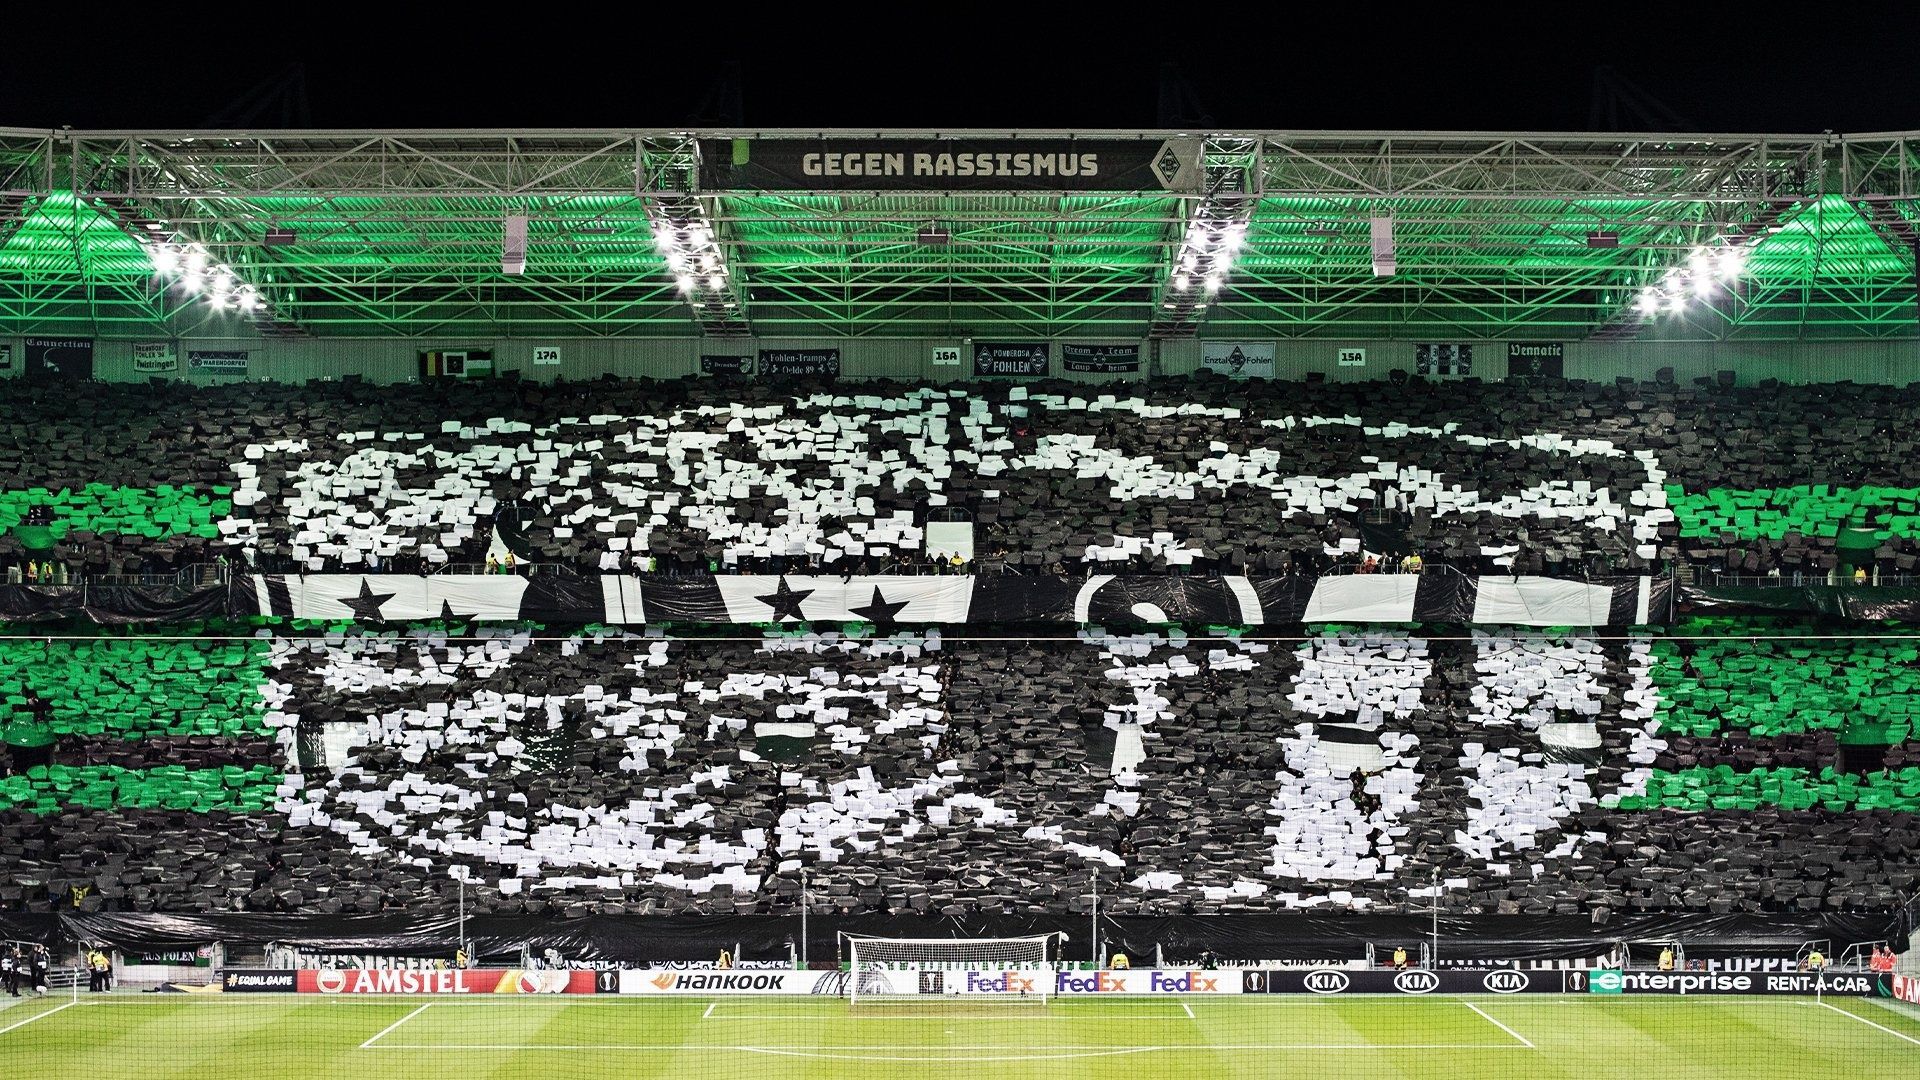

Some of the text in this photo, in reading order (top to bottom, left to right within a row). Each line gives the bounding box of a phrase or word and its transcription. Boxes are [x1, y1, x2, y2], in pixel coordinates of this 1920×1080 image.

[803, 153, 1098, 176] GEGEN RASSISMUS
[26, 338, 91, 348] Connection
[537, 351, 557, 359] 17A
[770, 353, 827, 363] Fohlen-Tramps
[935, 352, 957, 360] 16A
[993, 349, 1030, 357] PONDEROSA
[1341, 352, 1362, 361] 15A
[136, 360, 175, 369] Twistringen
[1204, 356, 1273, 364] Enztal Fohlen
[782, 366, 804, 374] Oelde
[993, 361, 1031, 373] FOHLEN
[142, 951, 161, 961] AUS
[162, 951, 195, 962] POLEN
[227, 973, 293, 987] #EQUALGAME
[353, 970, 470, 992] AMSTEL
[967, 971, 1035, 992] FedEx
[1059, 971, 1126, 992] FedEx
[1151, 971, 1217, 992] FedEx
[1311, 974, 1342, 988] KIA
[1401, 974, 1432, 988] KIA
[1491, 974, 1522, 988] KIA
[1594, 972, 1868, 994] enterprise RENT-A-CAR
